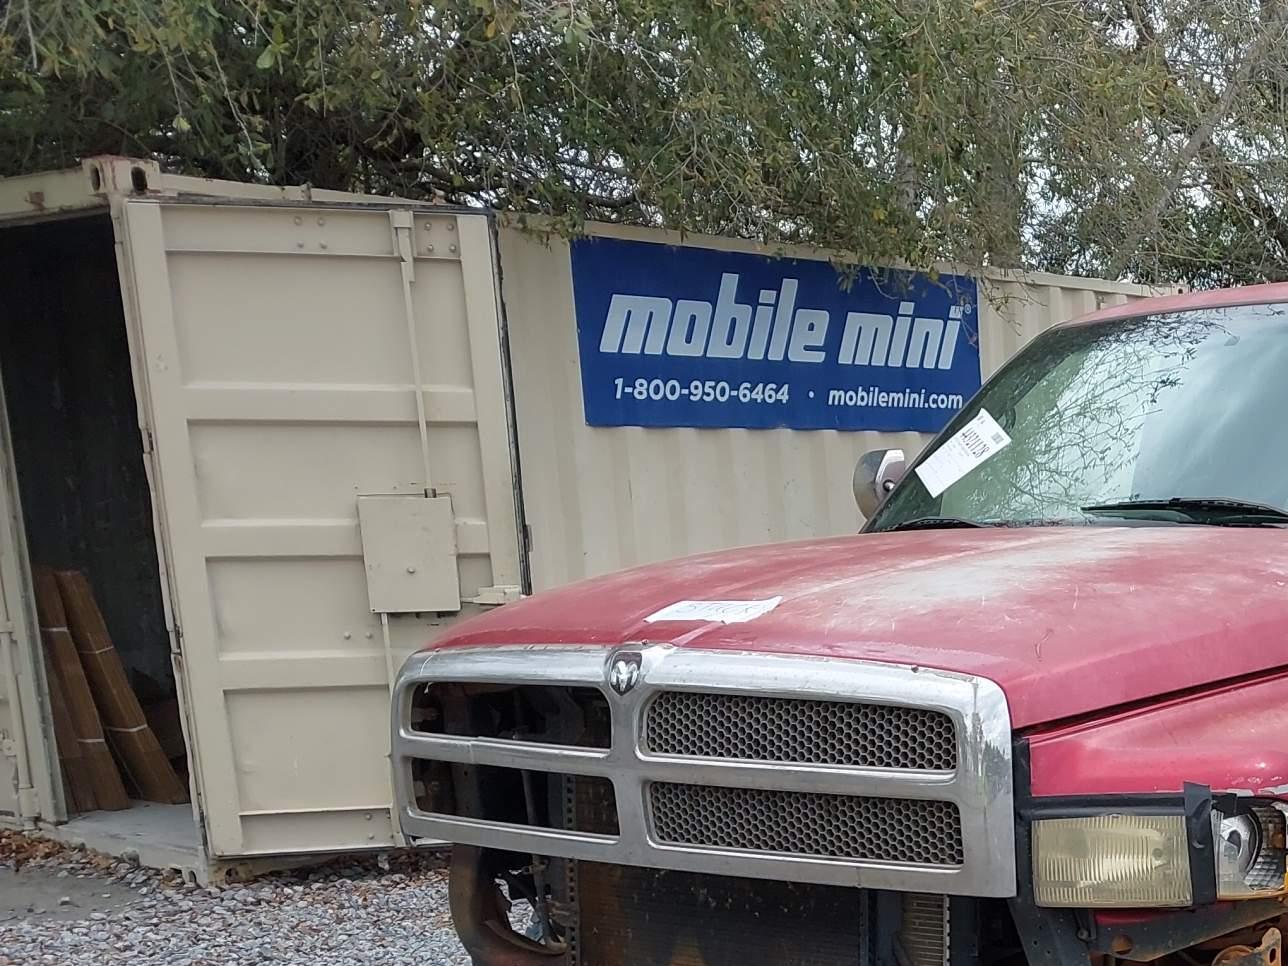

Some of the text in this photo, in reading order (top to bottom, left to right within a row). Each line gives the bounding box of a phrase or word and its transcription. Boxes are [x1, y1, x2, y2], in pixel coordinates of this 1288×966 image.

[600, 273, 961, 370] mobile mini
[614, 377, 963, 409] 1-800-950-6464 mobilemini.com
